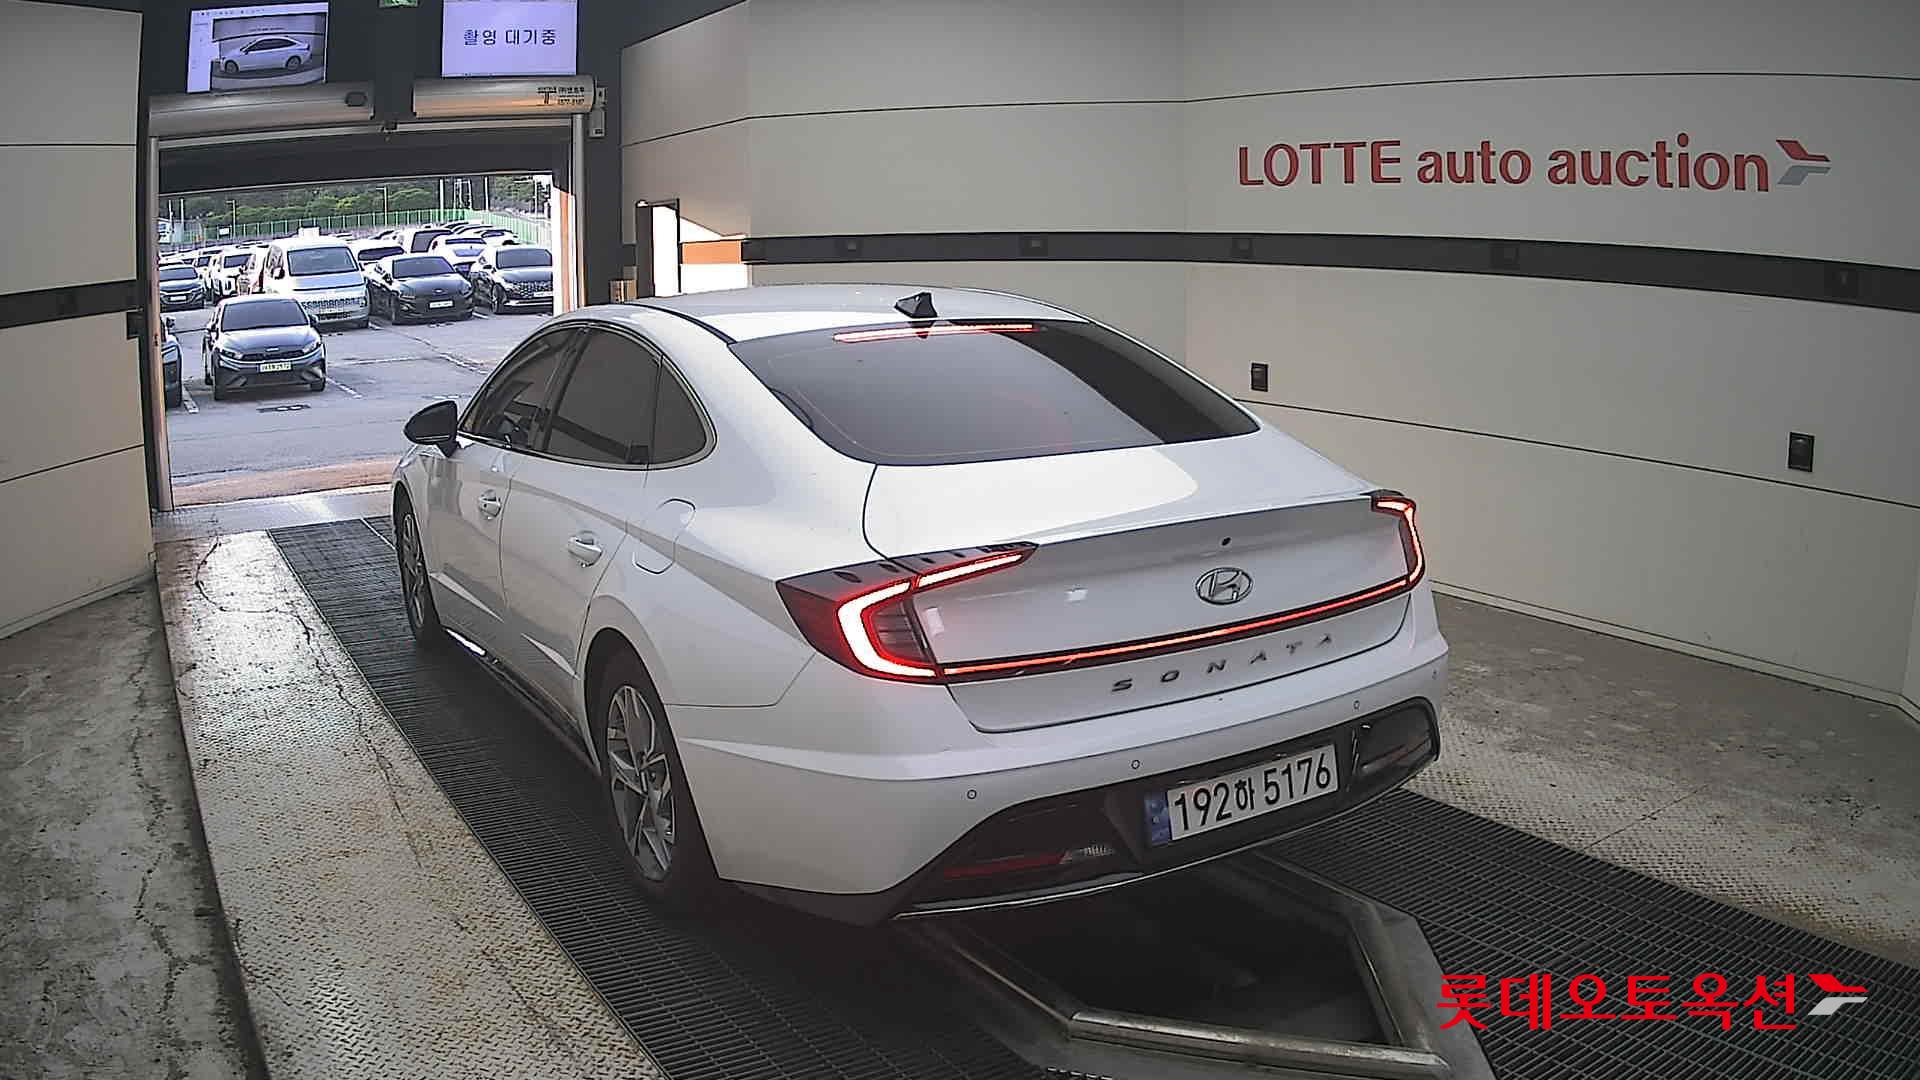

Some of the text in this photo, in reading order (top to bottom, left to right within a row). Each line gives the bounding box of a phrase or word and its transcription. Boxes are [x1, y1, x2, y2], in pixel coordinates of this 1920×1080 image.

[463, 29, 557, 46] 촬영 대기중
[1238, 132, 1770, 192] LOTTE auto auction
[1111, 634, 1333, 692] SONATA
[1174, 752, 1332, 831] 192하 5176
